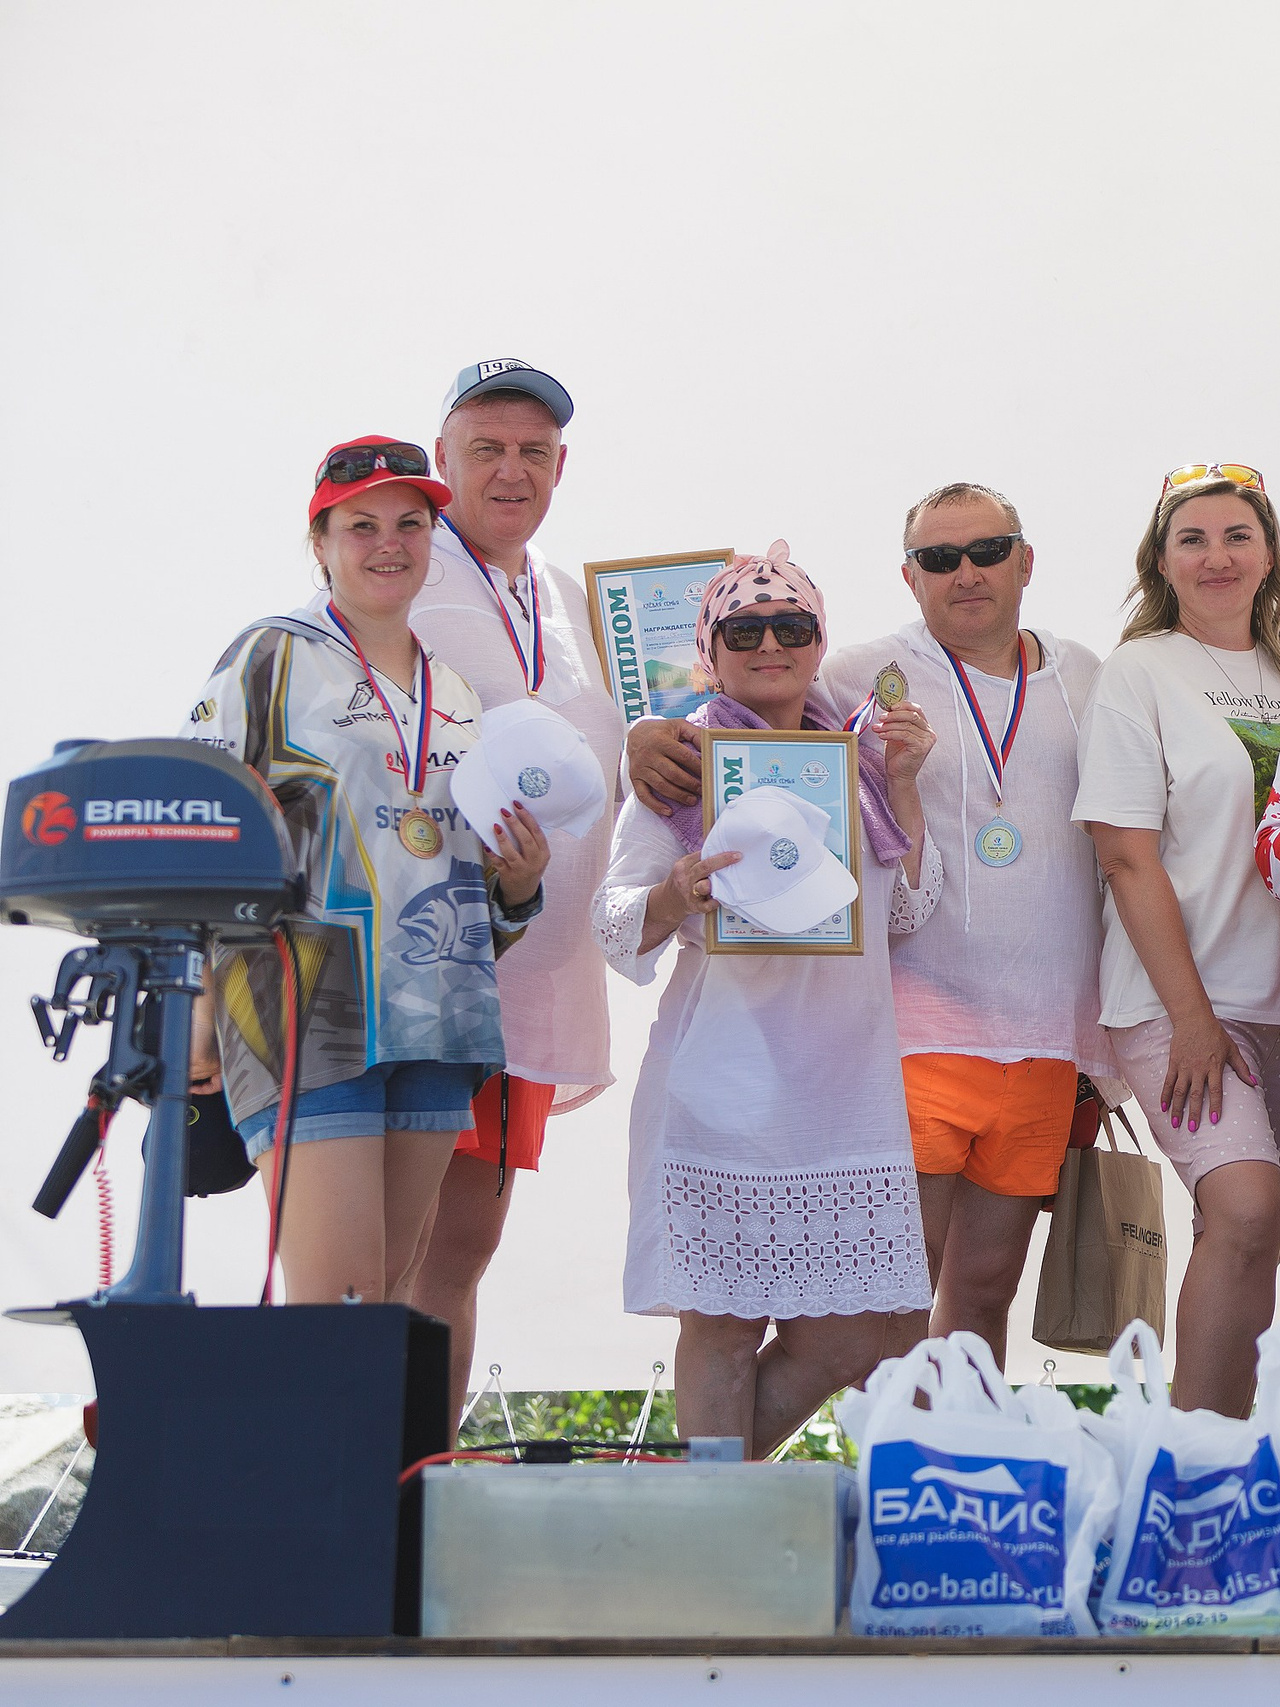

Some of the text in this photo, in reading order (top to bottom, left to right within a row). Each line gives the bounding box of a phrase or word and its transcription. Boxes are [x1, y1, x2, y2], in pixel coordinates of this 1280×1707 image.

[643, 622, 696, 633] НАГРАЖДАЕТСЯ
[607, 586, 648, 724] ДИПЛОМ
[1204, 691, 1253, 707] Yellow
[84, 799, 241, 824] BAIKAL
[92, 829, 234, 838] POWERFUL TECHNOLOGIES
[234, 902, 260, 921] CE
[873, 1485, 1058, 1536] БАДИС
[875, 1533, 896, 1545] все
[897, 1530, 925, 1545] для
[926, 1527, 990, 1546] рыбалки
[879, 1571, 1063, 1603] ooo-badis.ru
